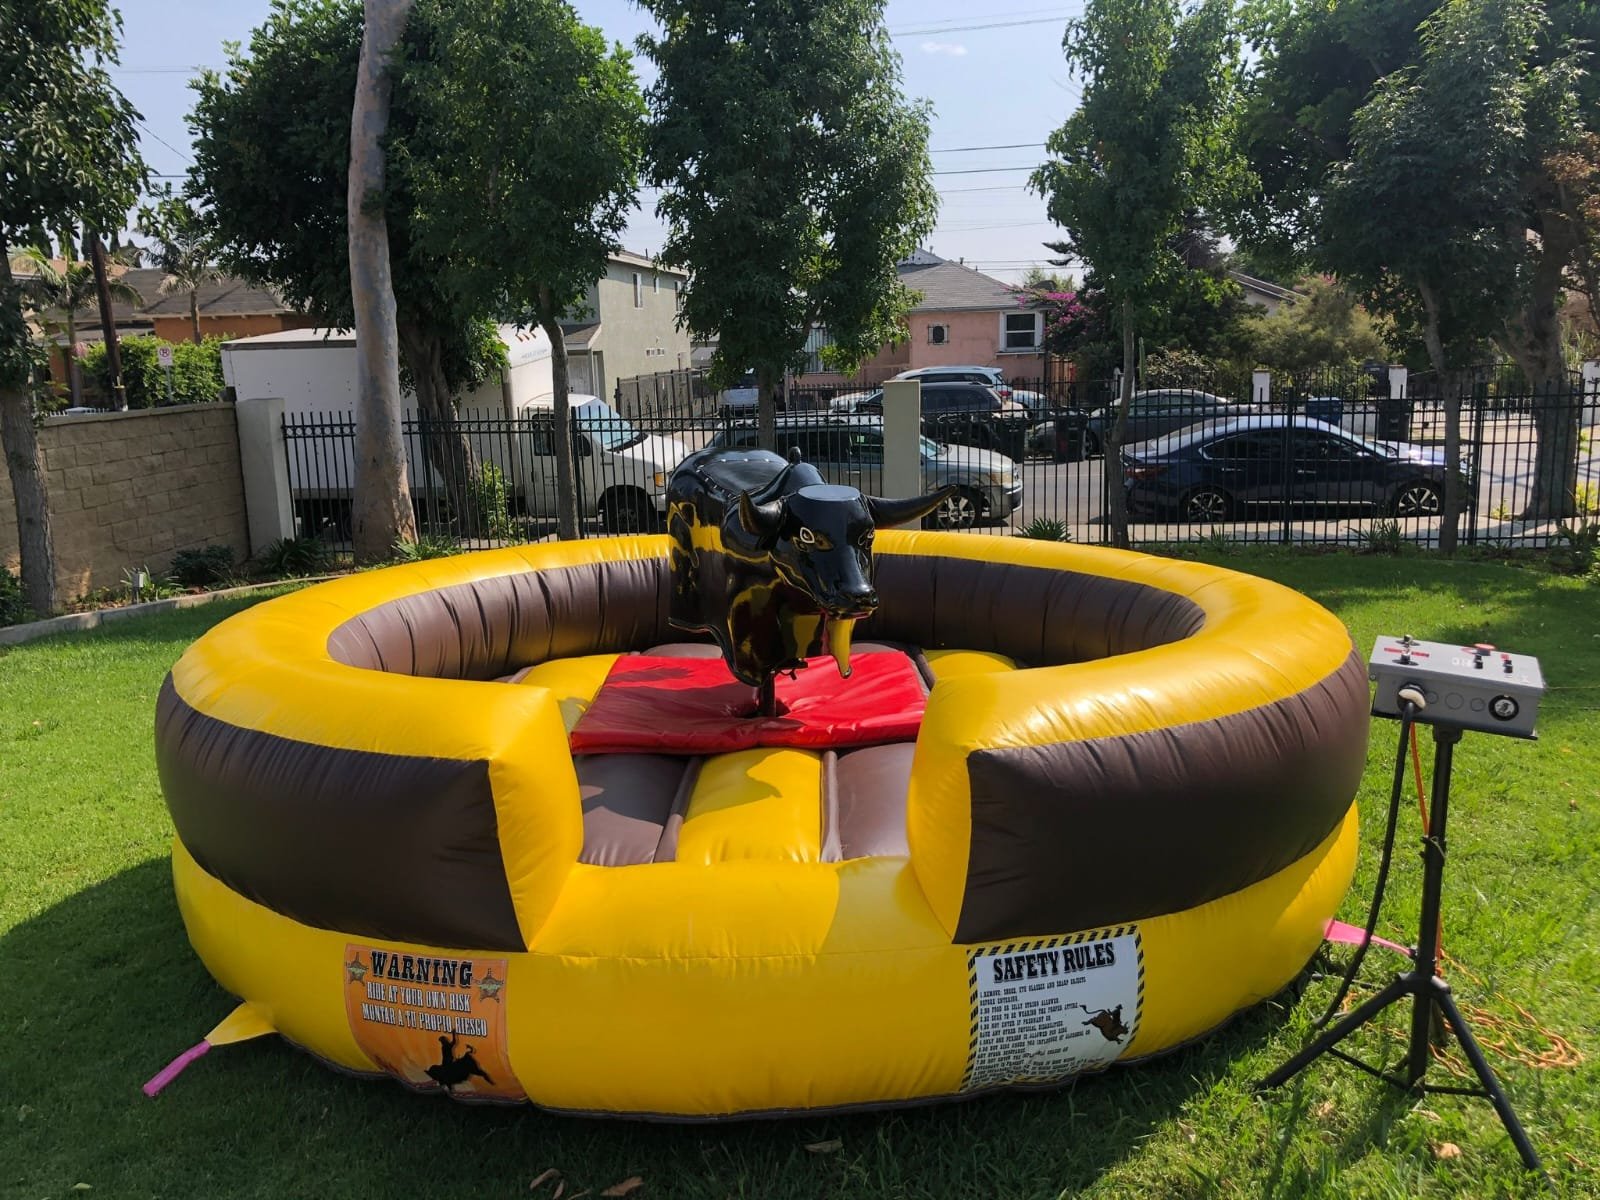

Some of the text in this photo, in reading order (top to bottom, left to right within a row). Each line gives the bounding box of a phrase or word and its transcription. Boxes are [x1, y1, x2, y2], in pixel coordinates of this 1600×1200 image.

[371, 950, 473, 988] WARNING
[993, 942, 1116, 982] SAFETY RULES
[367, 982, 471, 1012] RIDE AT YOUR OWN RISK
[362, 1003, 396, 1025] MONTAR
[398, 1009, 404, 1026] A
[406, 1010, 416, 1028] TU
[419, 1012, 452, 1032] PROPIO
